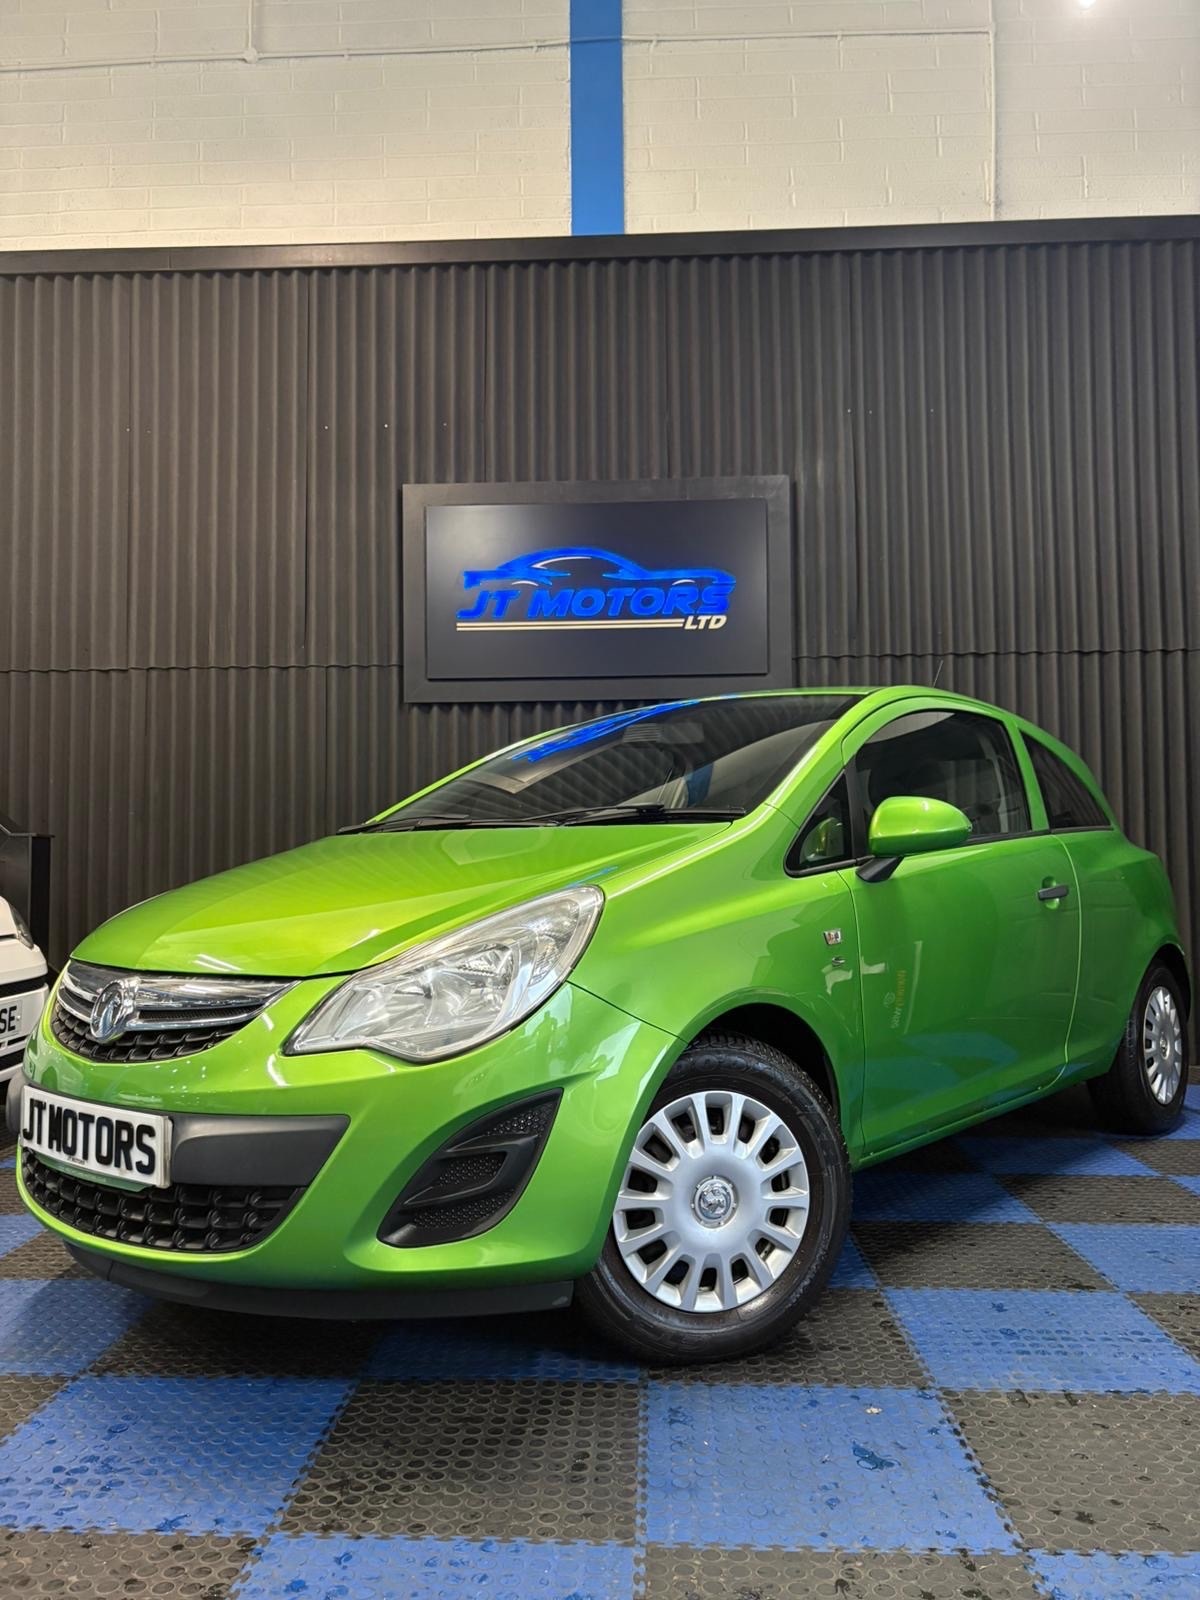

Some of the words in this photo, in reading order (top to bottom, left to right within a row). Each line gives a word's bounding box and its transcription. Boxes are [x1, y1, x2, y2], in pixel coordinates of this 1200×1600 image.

[456, 589, 521, 619] JT
[527, 585, 735, 618] MOTORS
[683, 614, 727, 630] LTD
[22, 1098, 47, 1145] JT
[48, 1103, 156, 1175] MOTORS
